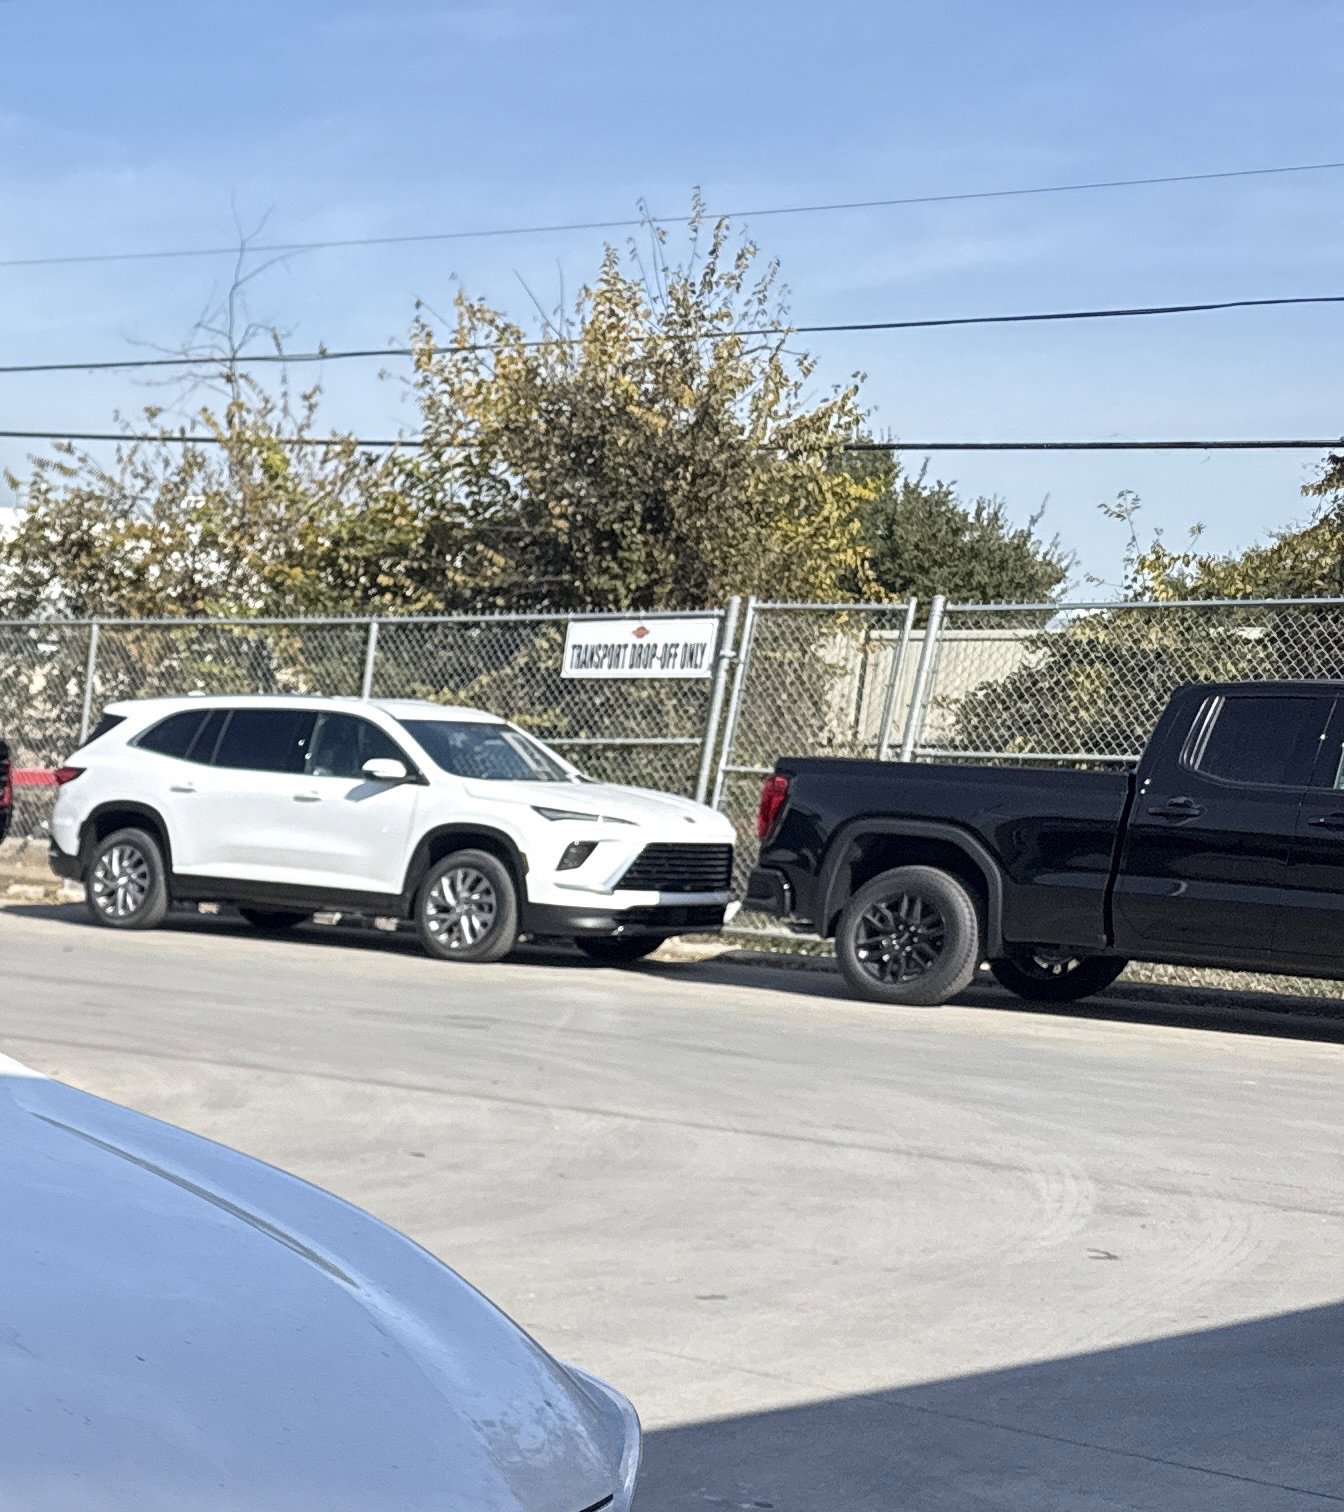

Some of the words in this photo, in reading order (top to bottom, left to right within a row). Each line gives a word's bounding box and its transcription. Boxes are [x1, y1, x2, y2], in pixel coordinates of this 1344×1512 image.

[570, 643, 628, 669] TRANSPORT
[629, 642, 680, 670] DROP-OFF
[680, 642, 707, 670] ONLY
